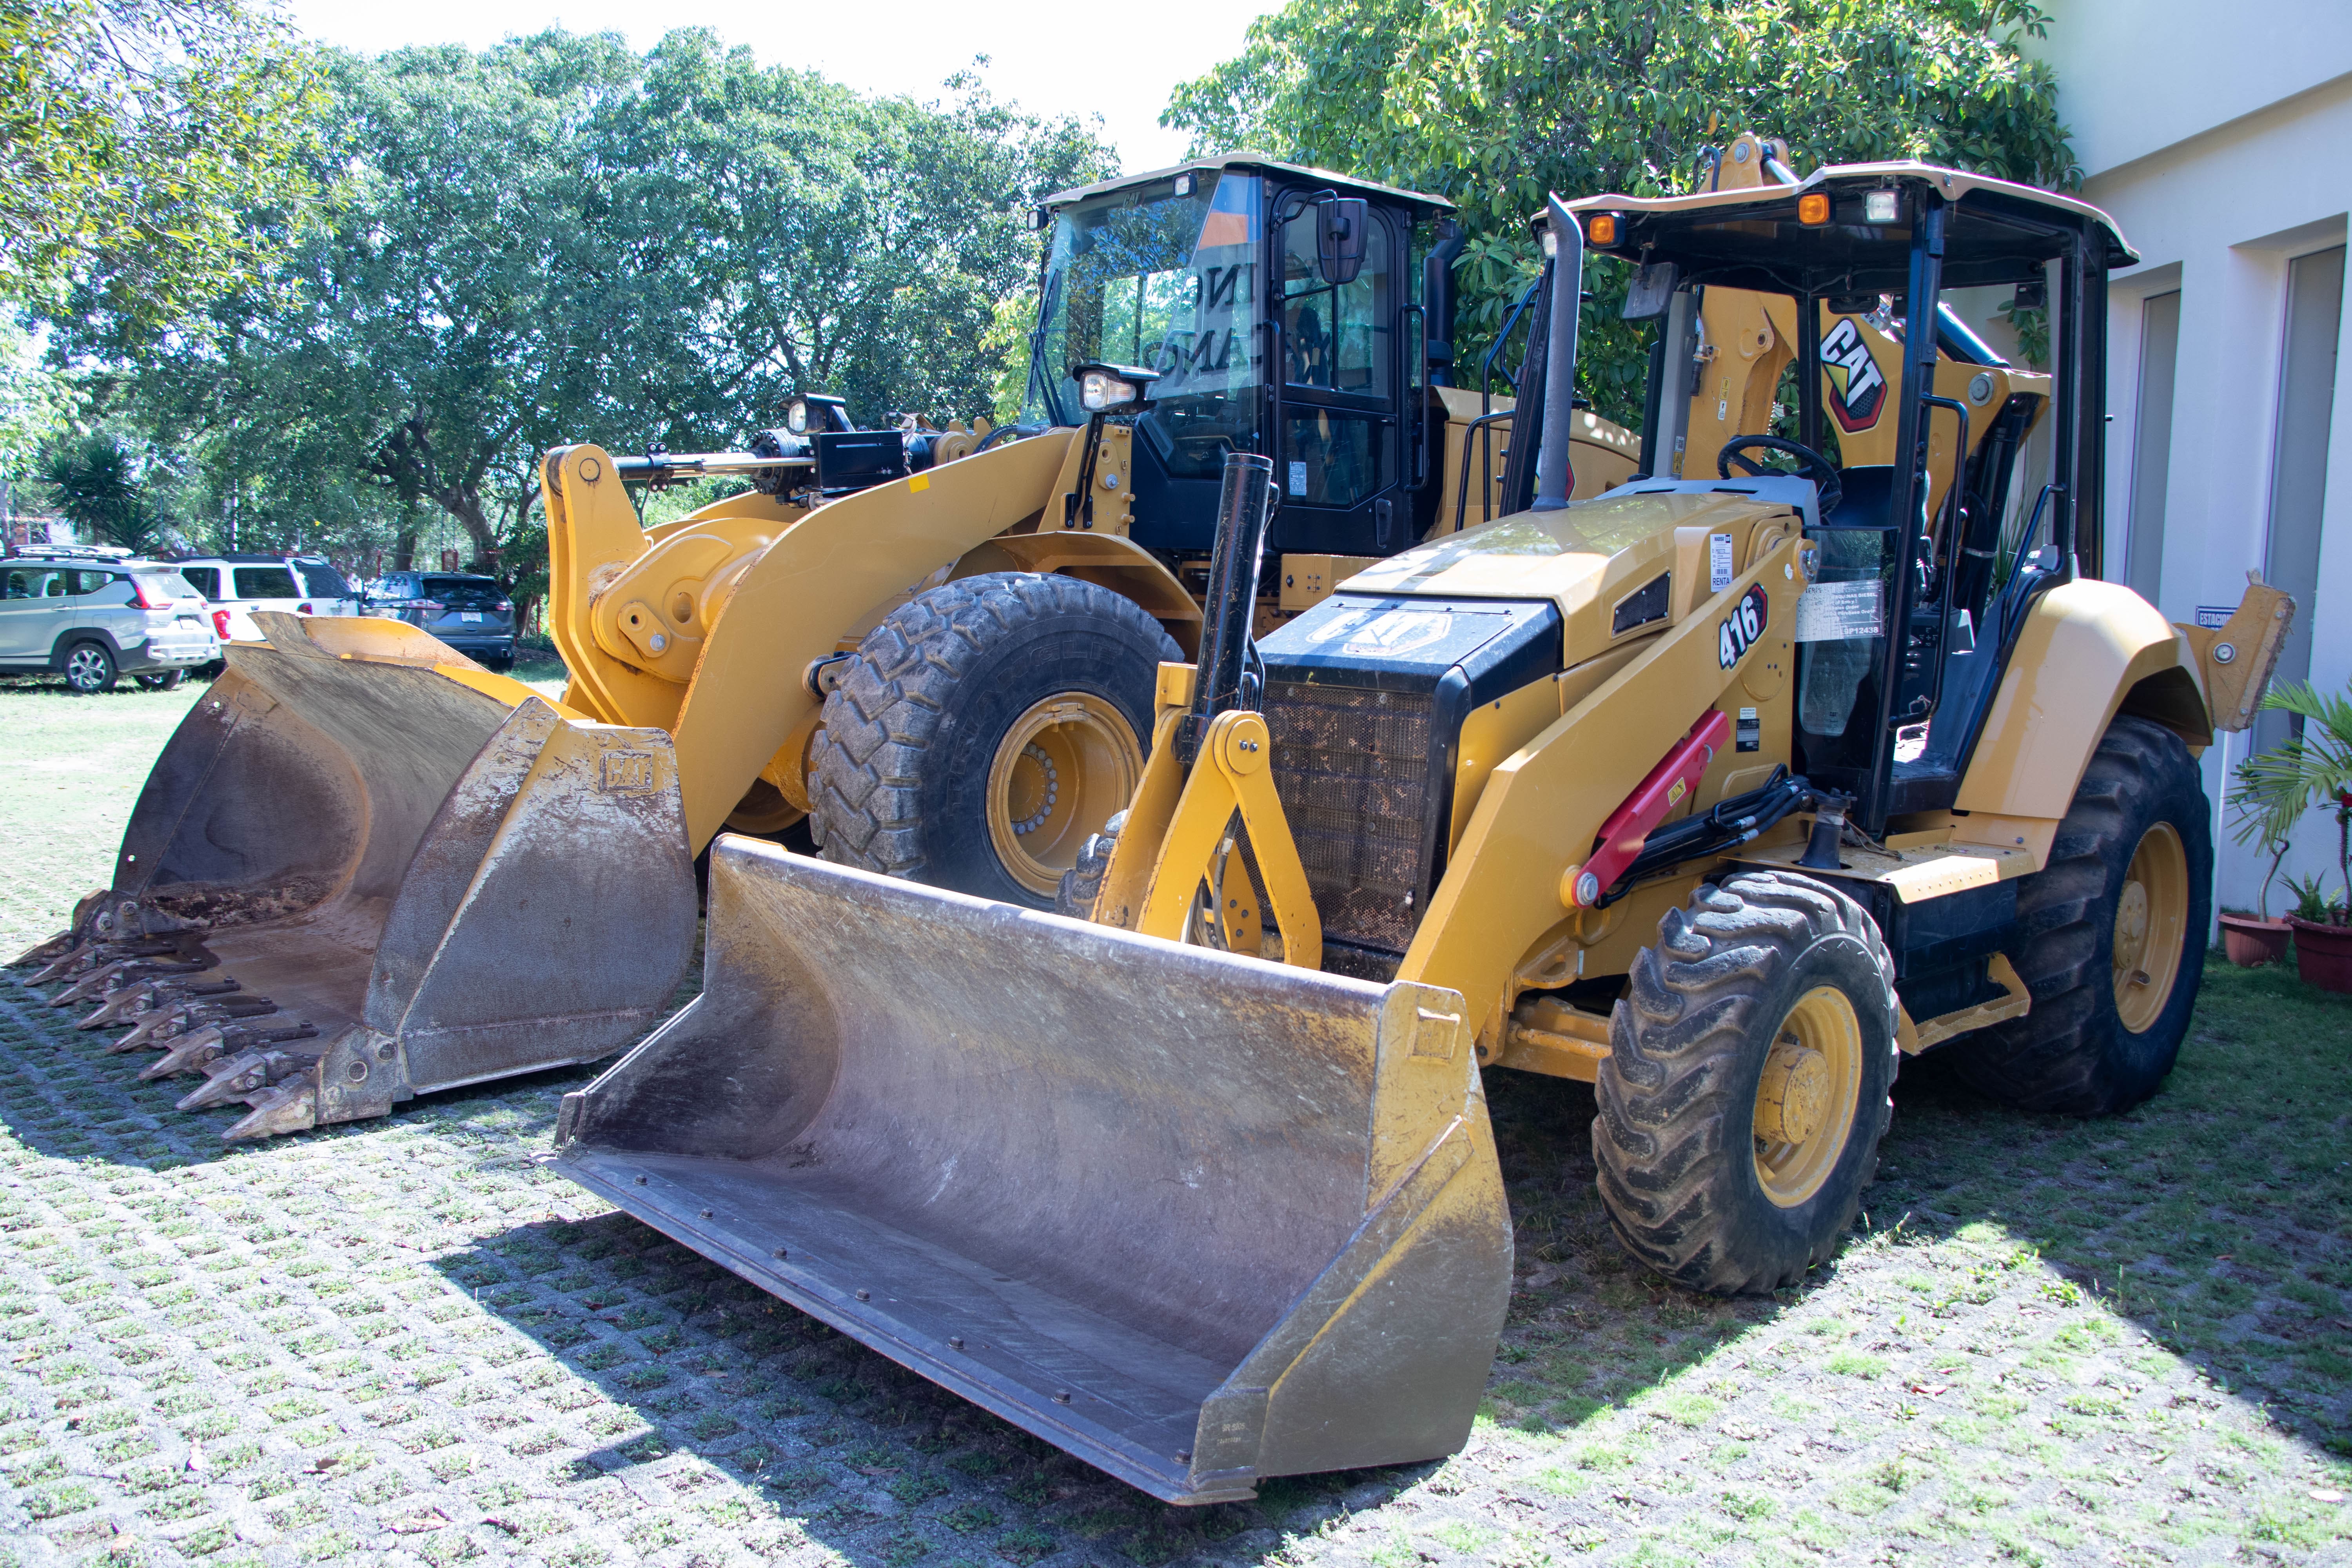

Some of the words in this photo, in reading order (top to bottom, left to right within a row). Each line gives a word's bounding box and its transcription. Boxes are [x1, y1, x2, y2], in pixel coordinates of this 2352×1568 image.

[1123, 192, 1141, 207] CAT
[1820, 319, 1882, 408] CAT
[1712, 577, 1730, 586] RENTA
[1720, 595, 1759, 666] 416
[608, 757, 651, 786] CAT
